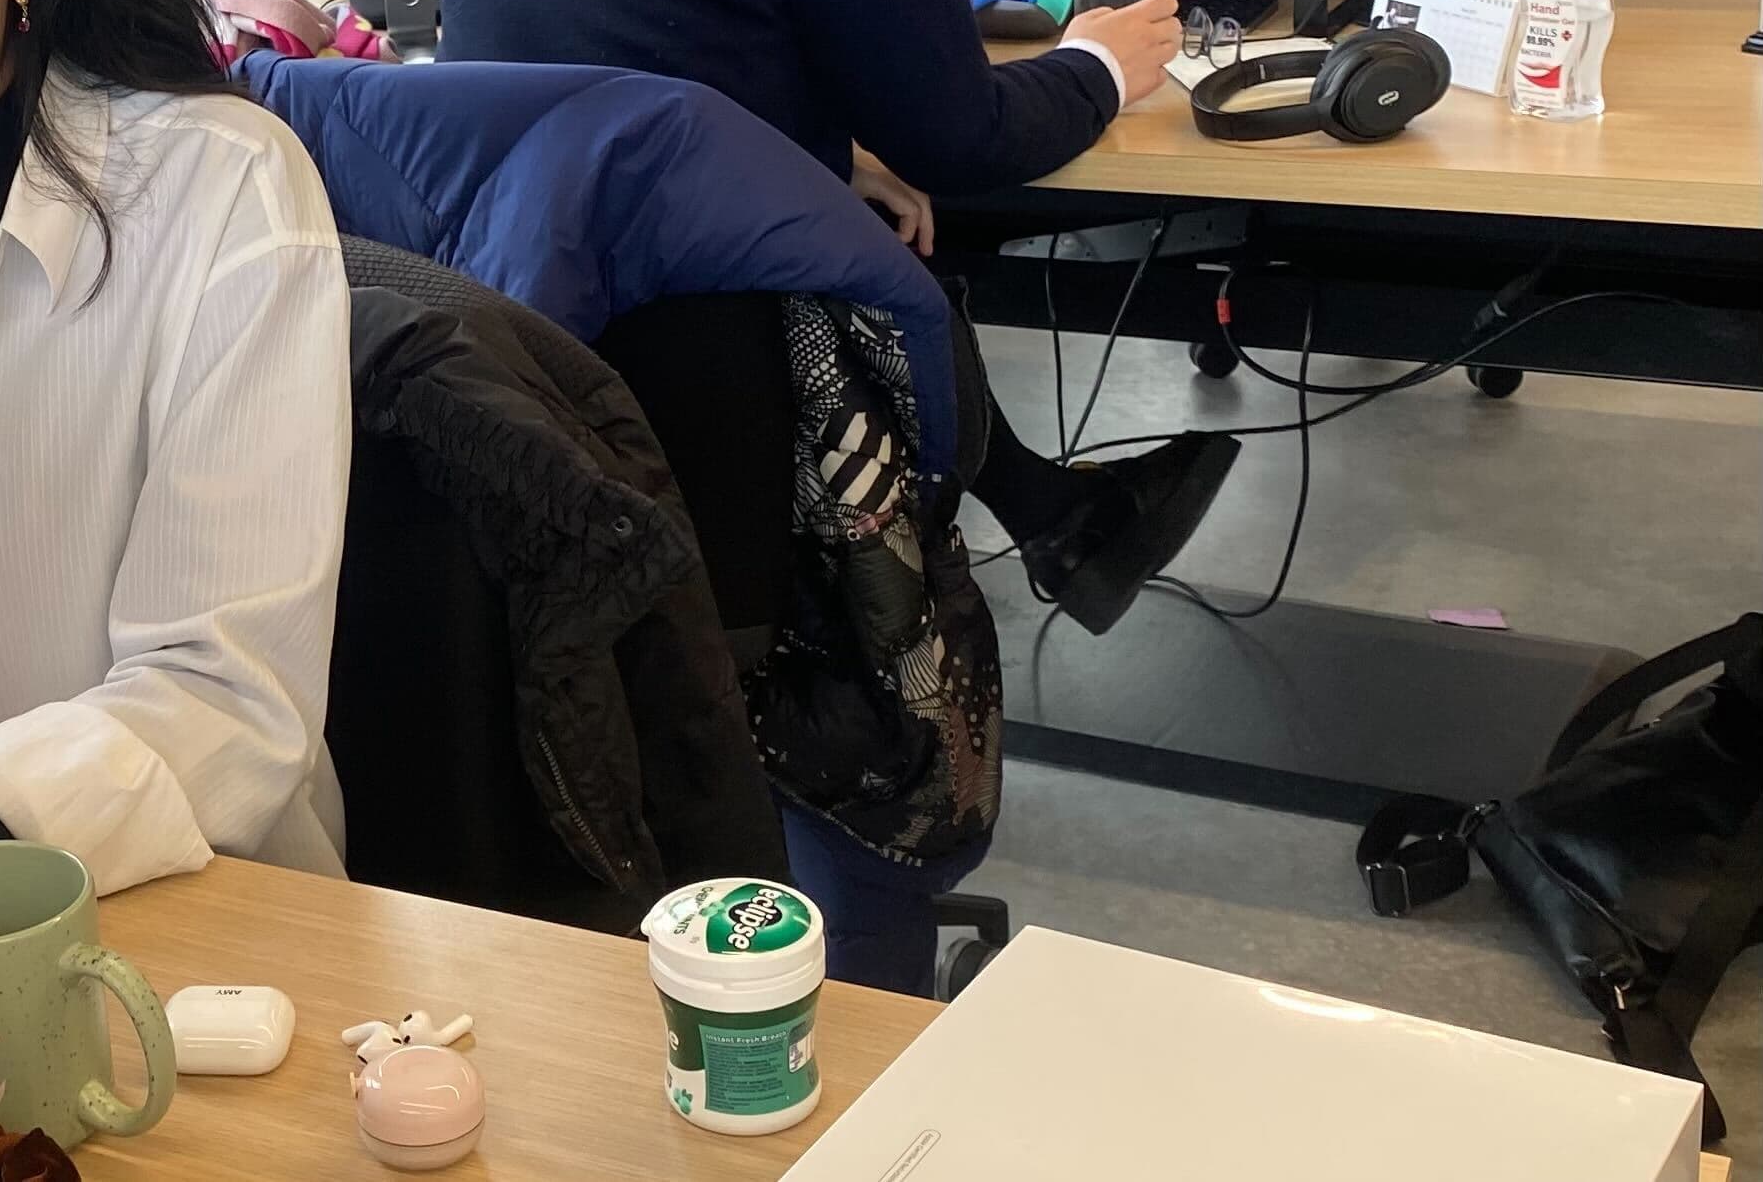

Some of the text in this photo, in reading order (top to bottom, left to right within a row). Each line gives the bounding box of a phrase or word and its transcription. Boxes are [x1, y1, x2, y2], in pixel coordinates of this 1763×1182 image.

[1530, 2, 1560, 15] Hand
[1529, 25, 1558, 38] KILLS
[1526, 35, 1555, 48] 99.99%
[1520, 49, 1552, 59] BACTERIA
[727, 888, 783, 949] eclipse
[705, 1034, 735, 1043] Instant
[736, 1036, 760, 1044] Fresh
